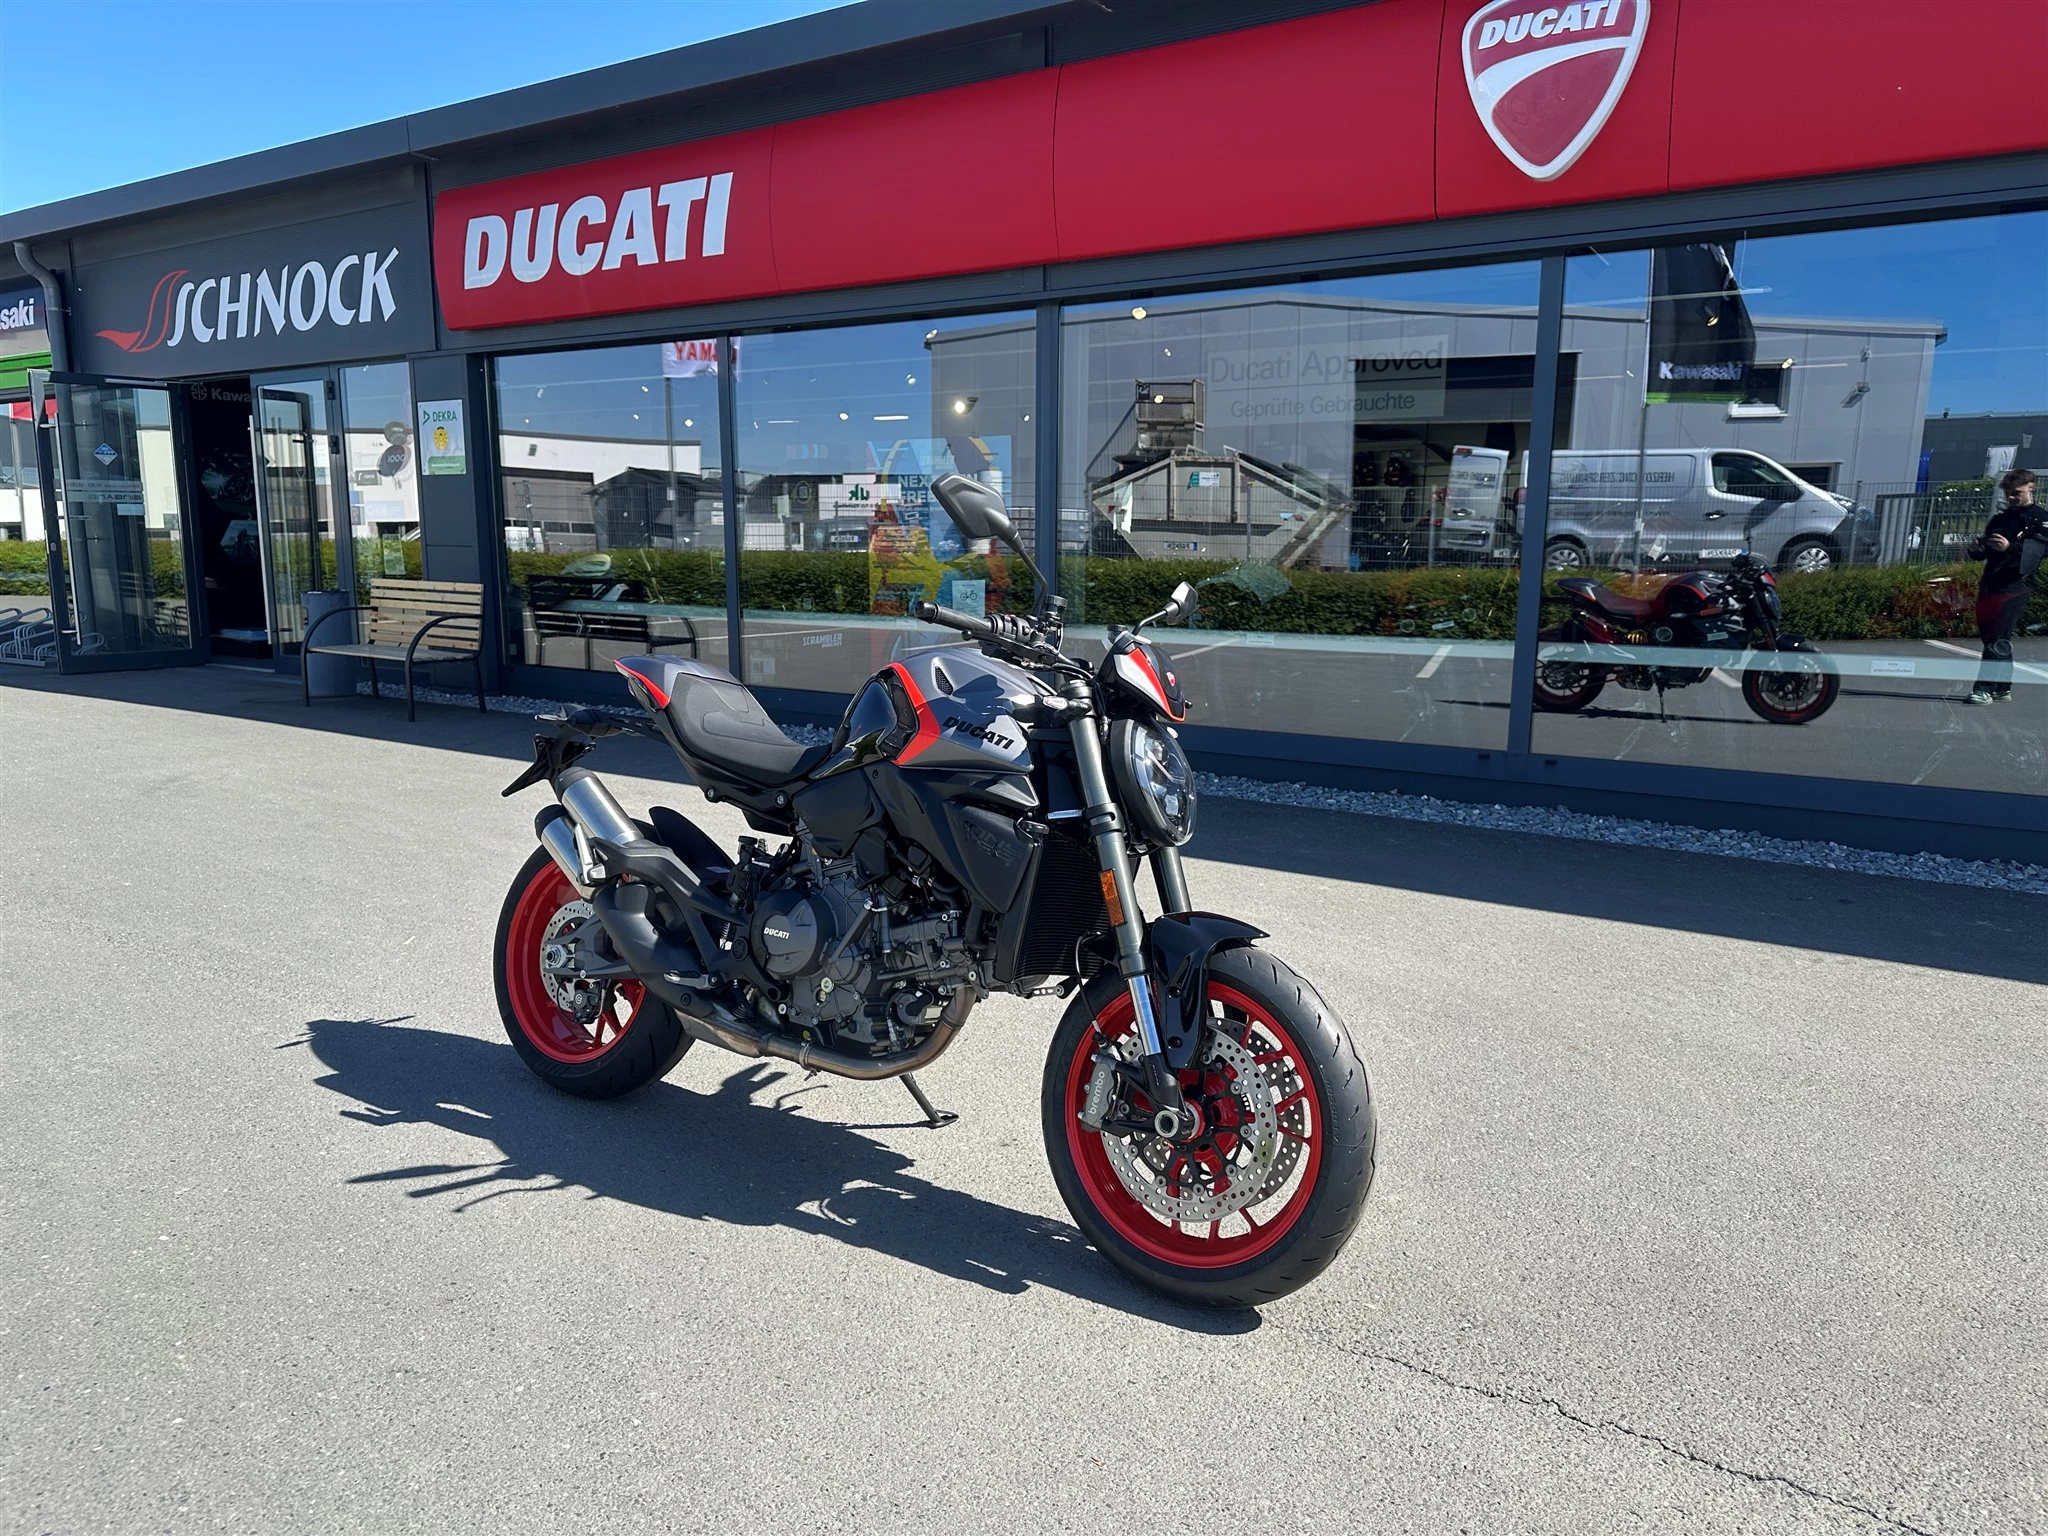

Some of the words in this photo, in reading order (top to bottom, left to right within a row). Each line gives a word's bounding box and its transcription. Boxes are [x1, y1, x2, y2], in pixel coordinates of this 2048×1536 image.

[1478, 0, 1621, 50] DUCATI
[464, 172, 734, 290] DUCATI
[167, 247, 399, 347] SCHNOCK
[0, 298, 35, 330] saki
[1211, 351, 1292, 383] Ducati
[1302, 341, 1444, 382] Approved
[1659, 361, 1743, 380] Kawasaki
[211, 387, 251, 403] Kawa
[1231, 397, 1305, 421] Geprüfte
[1310, 392, 1416, 415] Gebrauchte
[432, 411, 458, 422] DEKRA
[802, 632, 843, 646] SCRAMBLER
[942, 716, 1015, 750] DUCATI
[763, 927, 790, 939] DUCATI
[1088, 1071, 1105, 1115] brembo
